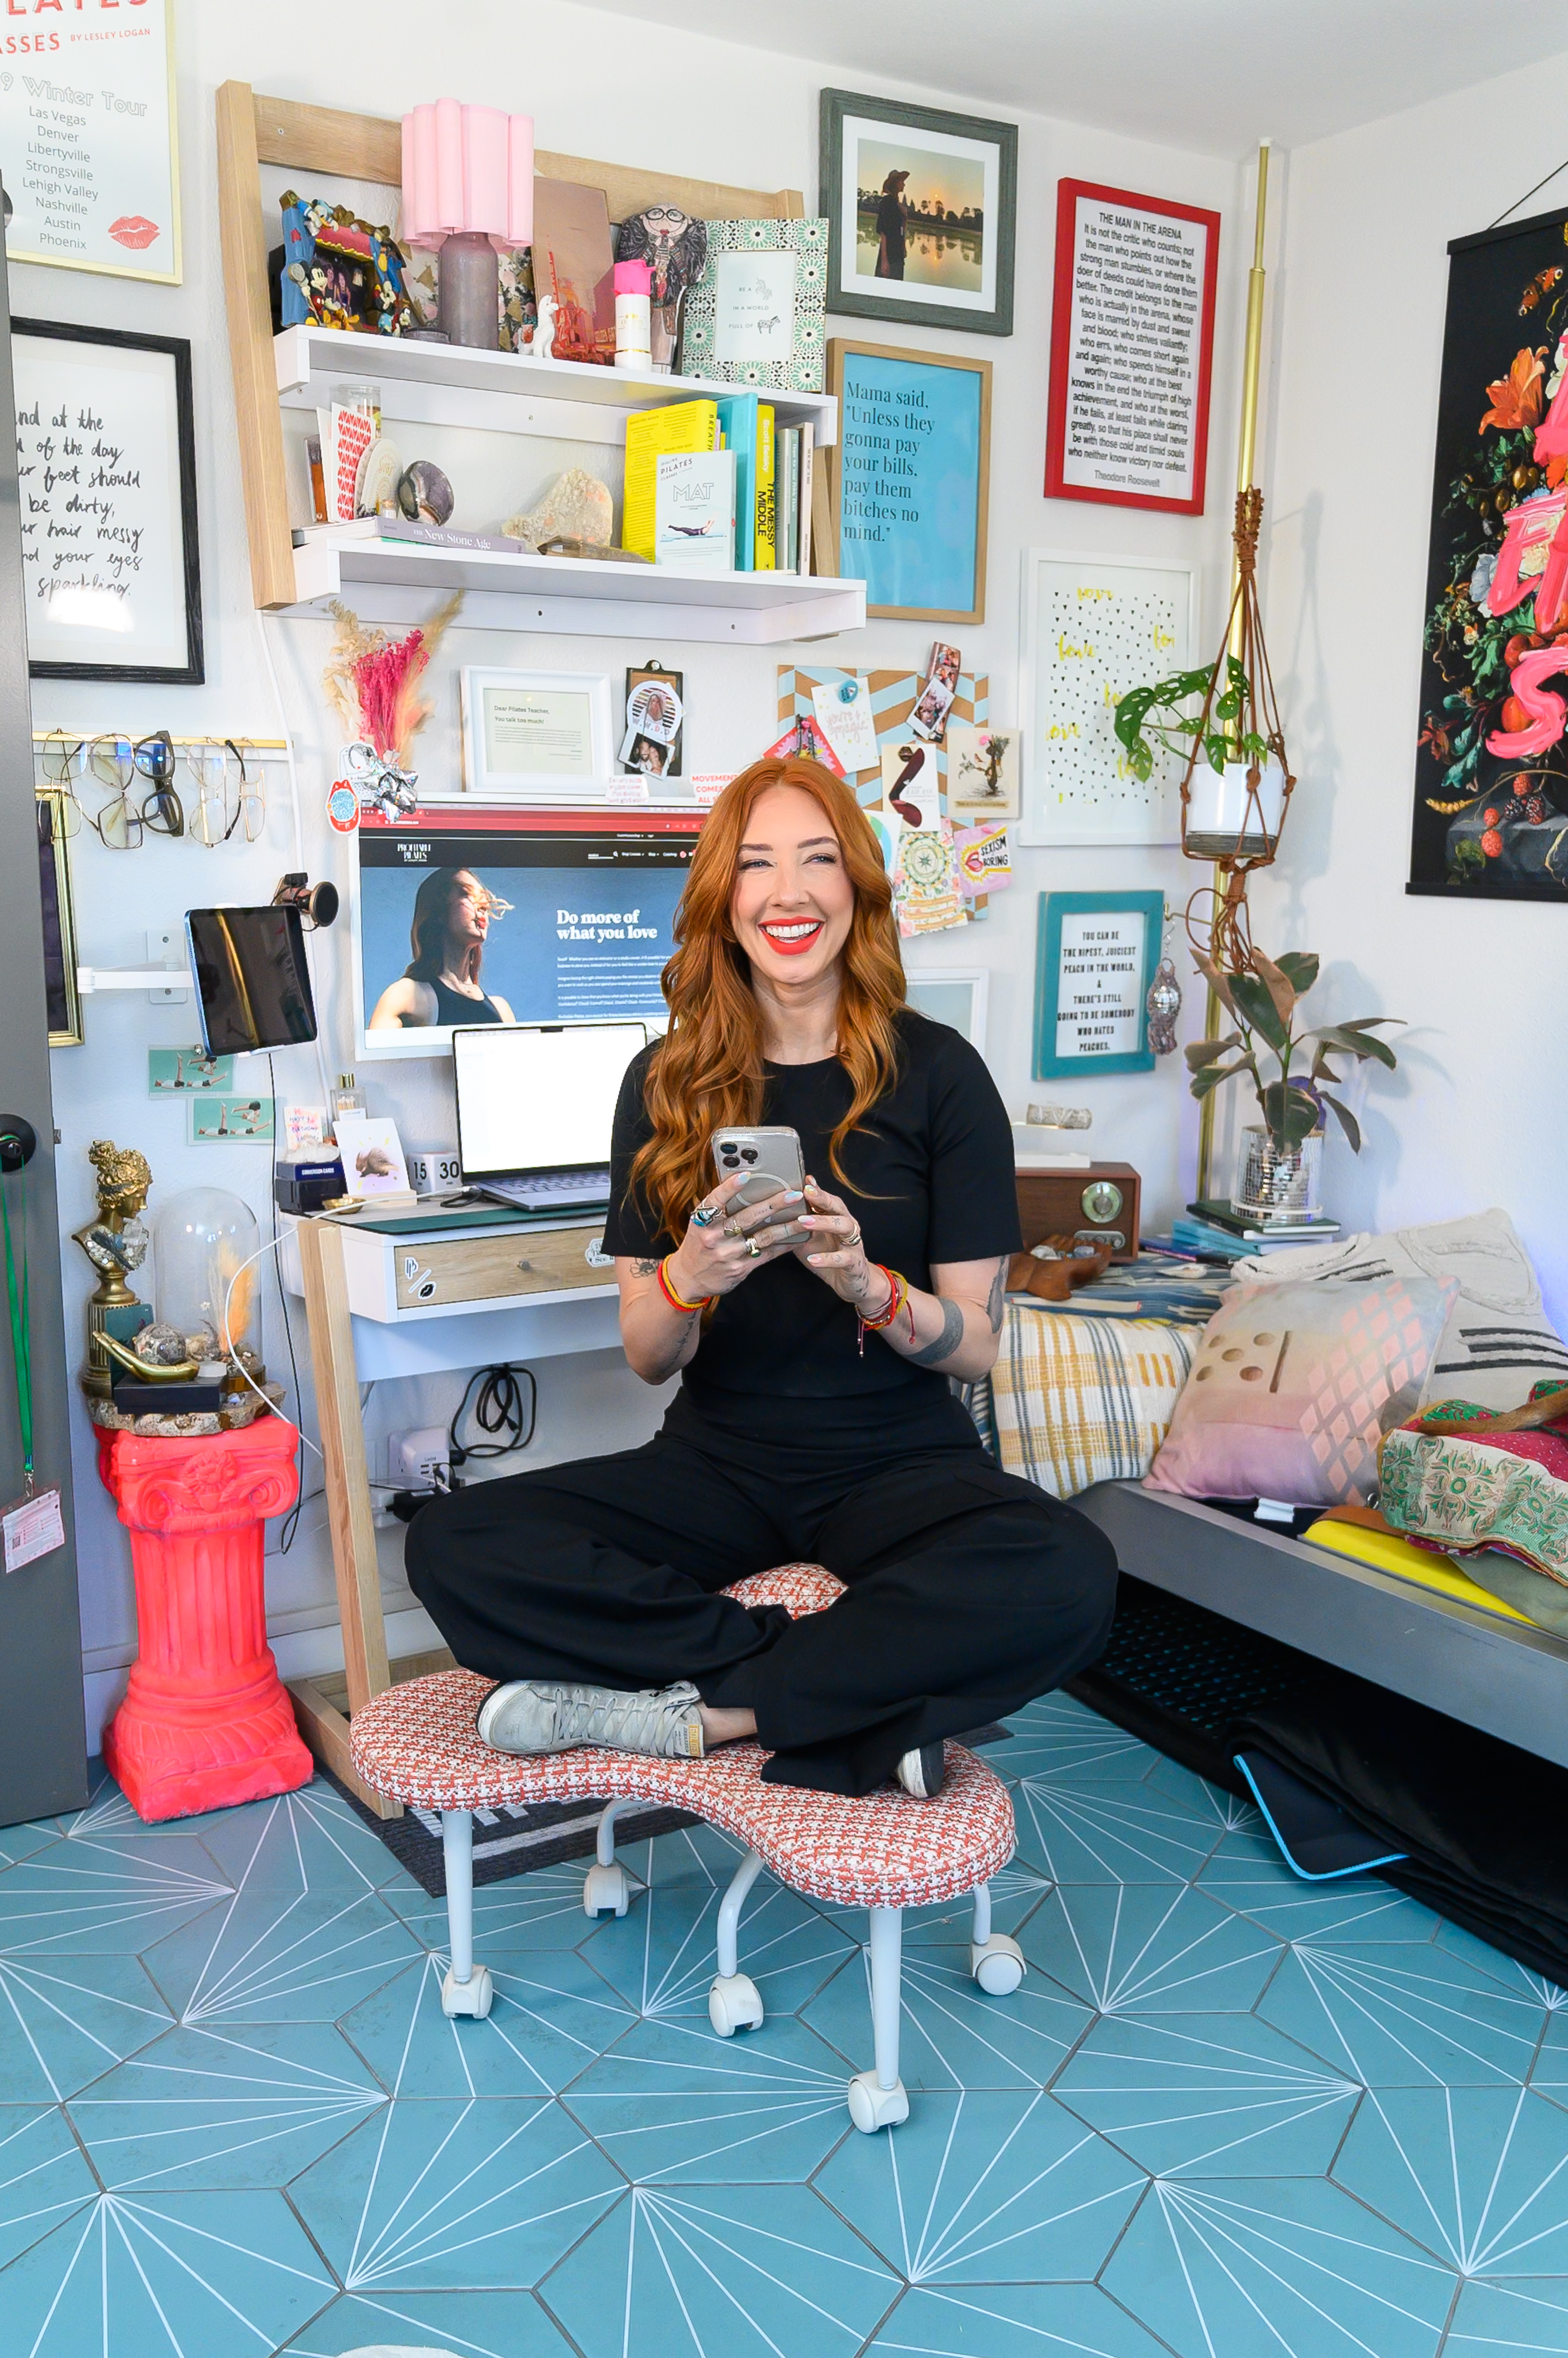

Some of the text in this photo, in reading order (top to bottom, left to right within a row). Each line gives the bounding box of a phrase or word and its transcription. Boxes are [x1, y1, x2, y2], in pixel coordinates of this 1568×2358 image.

[0, 31, 60, 54] SSES
[85, 31, 116, 40] LESLEY
[119, 28, 150, 38] LOGAN
[22, 76, 94, 106] Winter
[102, 91, 147, 116] Tour
[29, 105, 86, 127] Las Vegas
[37, 125, 79, 142] Denver
[28, 142, 90, 162] Libertyville
[26, 160, 93, 180] Strongsville
[22, 177, 98, 201] Lehigh Valley
[35, 196, 88, 215] Nashville
[44, 216, 81, 231] Austin
[1099, 213, 1182, 240] THE MAN IN THE ARENA
[40, 233, 87, 249] Phoenix
[1090, 225, 1097, 235] is
[1099, 228, 1110, 239] not
[1111, 230, 1122, 241] the
[1123, 233, 1140, 245] critic
[1142, 238, 1156, 248] who
[1183, 247, 1194, 257] not
[1086, 239, 1192, 270] the man who points out how the
[1080, 252, 1103, 267] strong
[1104, 259, 1119, 268] man
[1155, 268, 1163, 277] or
[1164, 270, 1185, 282] where
[1185, 274, 1196, 285] the
[847, 381, 891, 403] Mama
[16, 401, 104, 432] nd at the
[846, 405, 935, 435] "Unless they
[36, 436, 56, 461] of
[63, 436, 83, 456] the
[91, 438, 125, 469] day
[845, 433, 920, 456] gonna pay
[660, 458, 692, 474] PILATES
[845, 456, 878, 472] your
[44, 465, 81, 493] feet
[88, 465, 140, 488] should
[1095, 469, 1161, 488] Theodore Roosevelt
[673, 483, 714, 501] MAT
[845, 479, 911, 499] pay them
[28, 492, 115, 525] be dirty,
[757, 491, 767, 537] MIDDLE
[844, 498, 919, 522] bitches no
[47, 519, 82, 538] hair
[97, 527, 144, 553] messy
[767, 505, 775, 549] MESSY
[424, 529, 445, 540] New
[447, 533, 473, 546] Stone
[474, 538, 491, 549] Age
[53, 552, 95, 571] your
[106, 553, 143, 578] eyes
[981, 837, 1007, 856] SEXISM
[983, 855, 1008, 866] BORING
[556, 909, 640, 925] Do more of
[556, 925, 657, 944] what you love
[1083, 931, 1119, 940] YOU CAN BE
[1063, 948, 1076, 957] THE
[1105, 946, 1136, 956] JUICIEST
[1064, 964, 1085, 973] PEACH
[1087, 964, 1094, 973] IN
[1097, 963, 1108, 972] THE
[1103, 994, 1121, 1003] STILL
[1057, 1009, 1135, 1021] GOING TO BE SOMEBODY
[1077, 1026, 1115, 1036] WHO HATES
[414, 1162, 427, 1180] 15
[440, 1161, 459, 1179] 30
